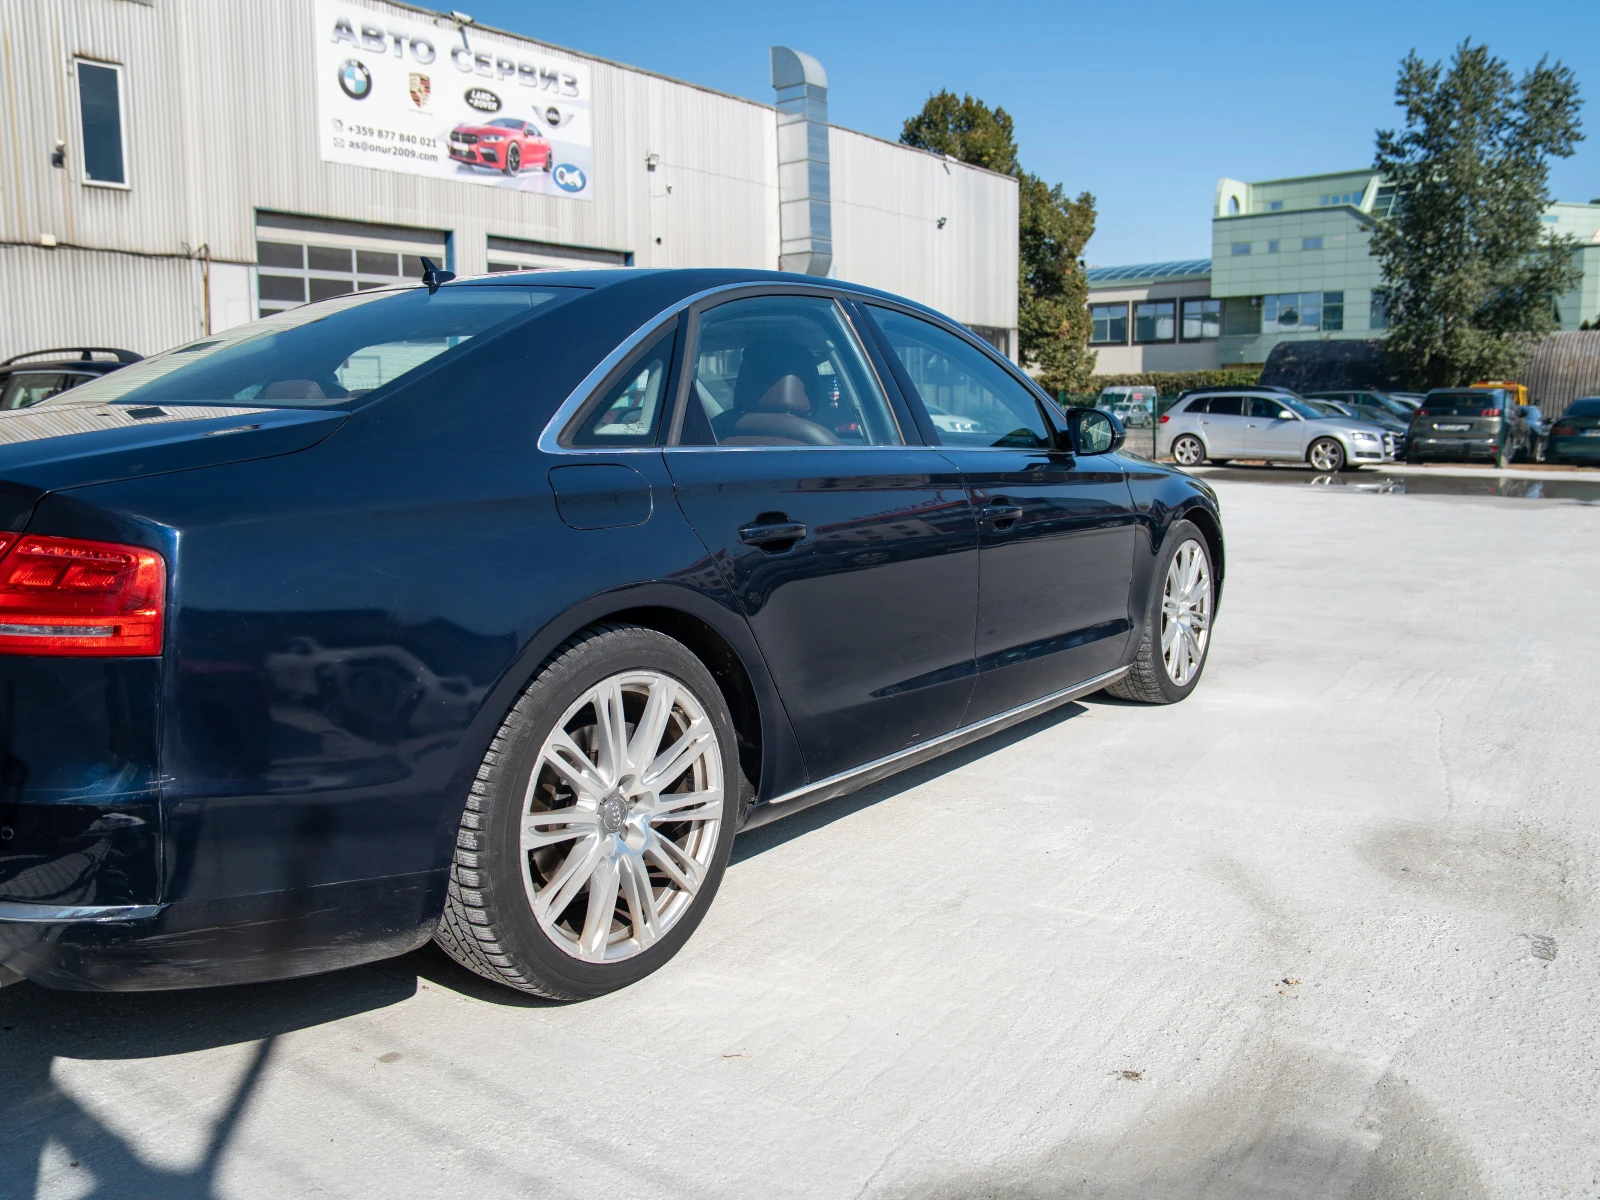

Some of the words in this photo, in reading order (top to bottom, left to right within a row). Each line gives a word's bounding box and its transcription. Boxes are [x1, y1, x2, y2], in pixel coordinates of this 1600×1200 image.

[330, 16, 437, 65] АВТО
[450, 44, 579, 98] СЕРВИЗ
[471, 89, 492, 102] LAND
[473, 98, 498, 111] ROVER
[348, 124, 374, 137] +359
[377, 129, 396, 141] 877
[399, 132, 417, 144] 840
[419, 136, 437, 148] 021
[348, 140, 439, 162] as@onur2009.com
